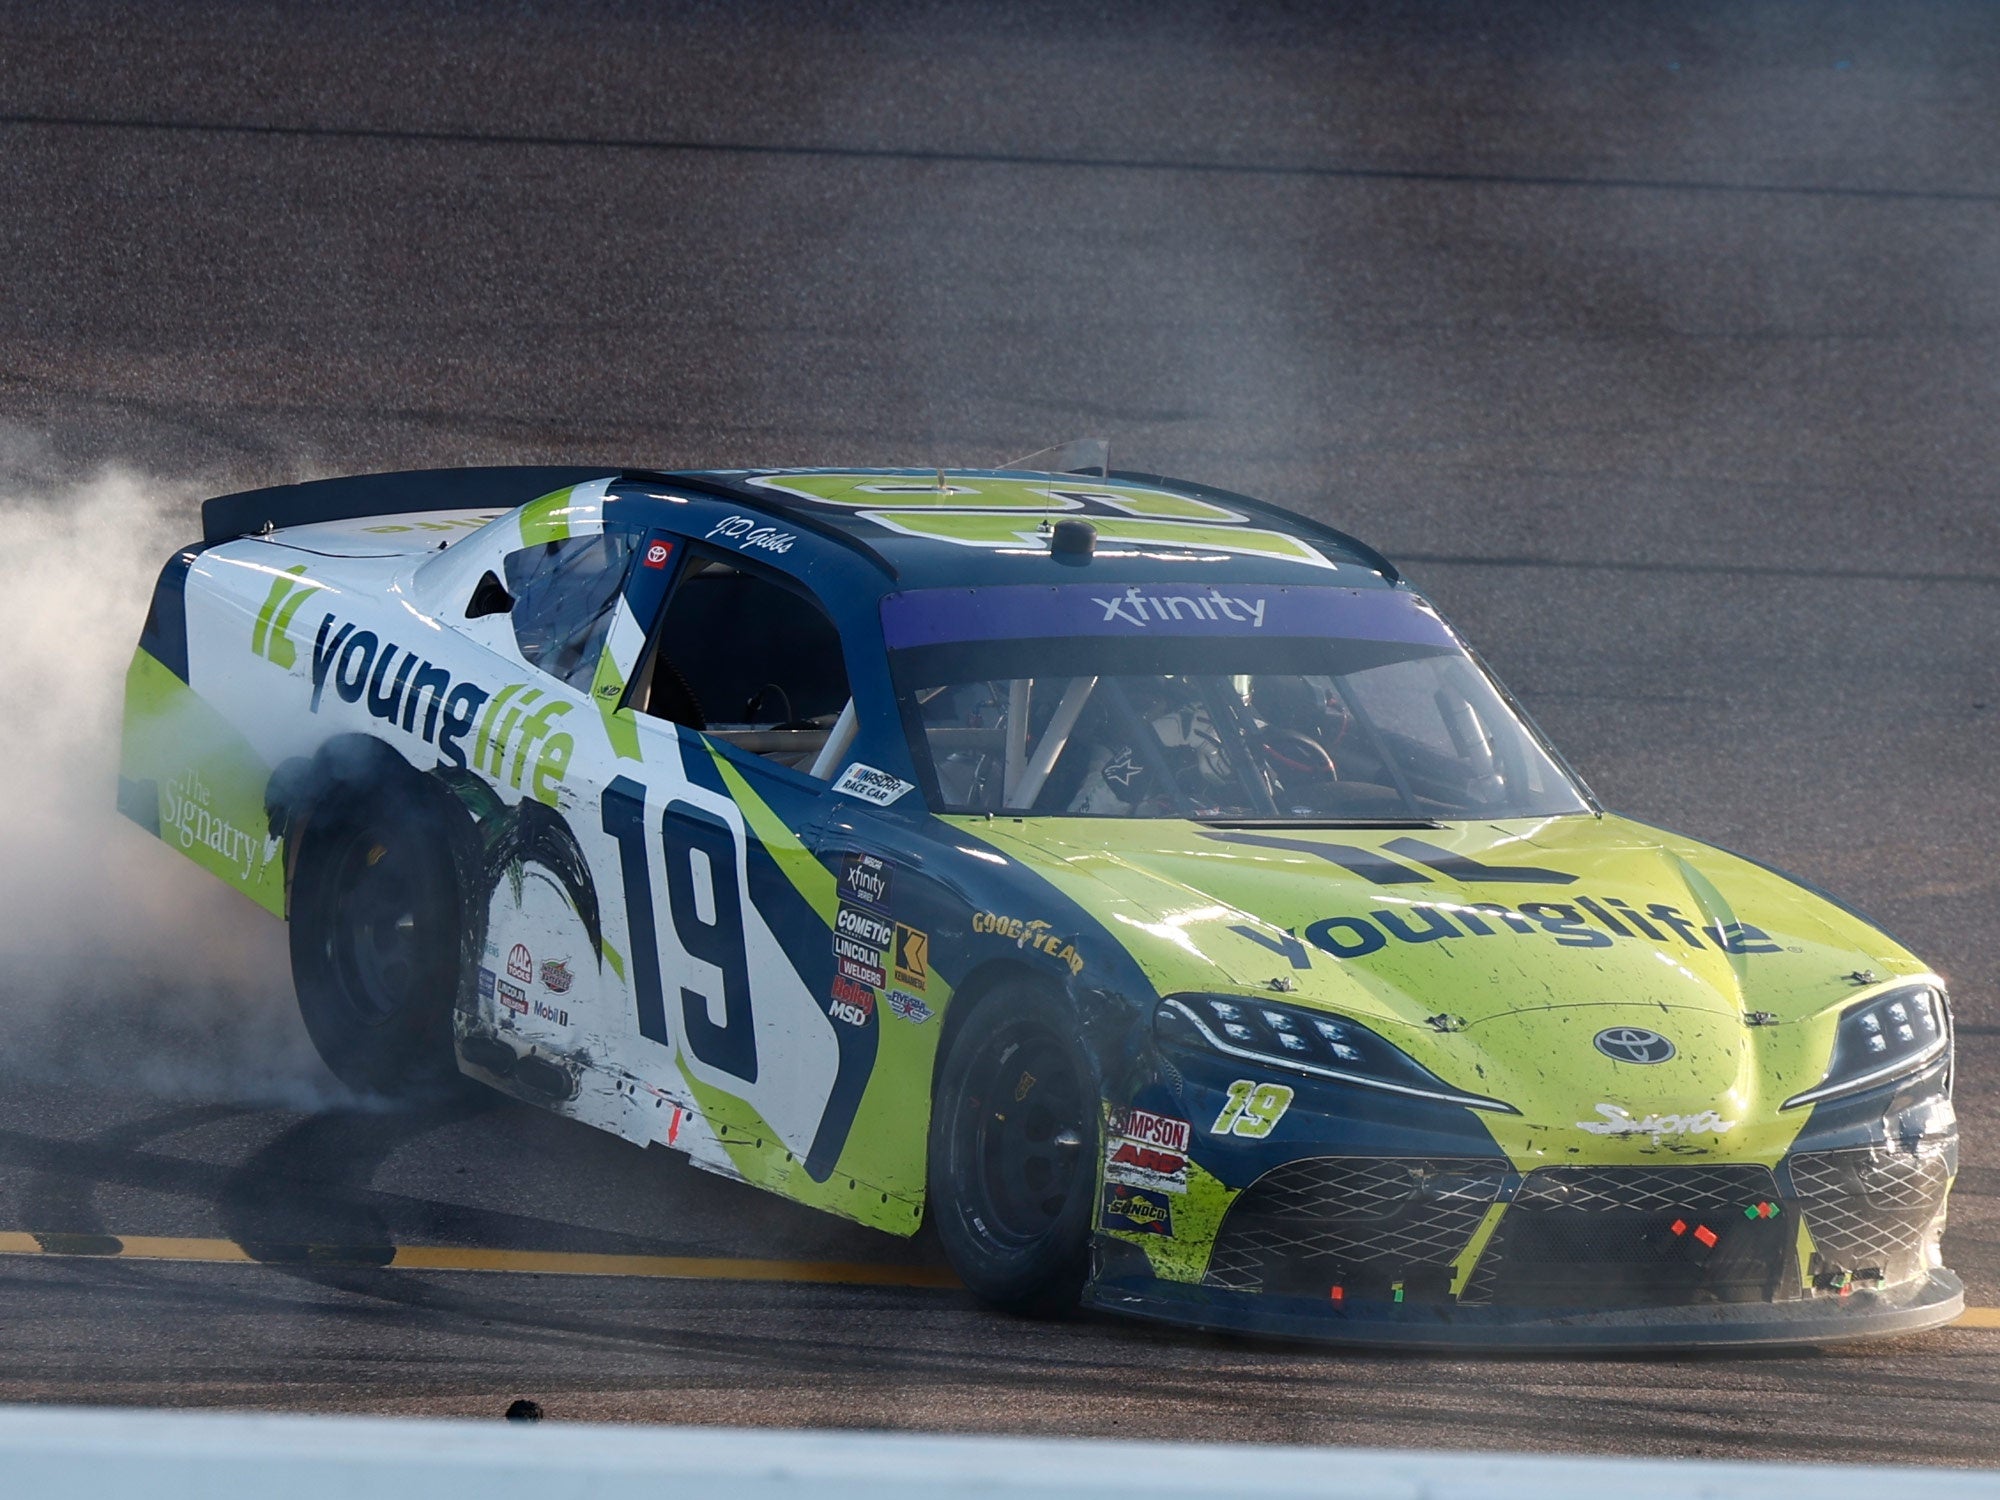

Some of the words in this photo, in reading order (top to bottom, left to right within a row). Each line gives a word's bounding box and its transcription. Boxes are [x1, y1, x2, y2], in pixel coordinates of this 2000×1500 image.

[738, 526, 797, 554] Gibbs
[1089, 587, 1266, 627] xfinity
[842, 779, 867, 794] RACE
[866, 787, 889, 801] CAR
[862, 770, 901, 792] NASCAR
[163, 778, 257, 880] Signatry
[847, 865, 886, 900] xfinity
[602, 774, 759, 1085] 19
[837, 909, 892, 945] COMETIC
[1226, 895, 1784, 970] younglife
[835, 937, 879, 968] LINCOLN
[508, 965, 531, 982] TOOLS
[843, 960, 881, 986] WELDERS
[534, 1000, 559, 1023] Mobil
[828, 1000, 866, 1026] MSD
[1210, 1079, 1295, 1139] 19
